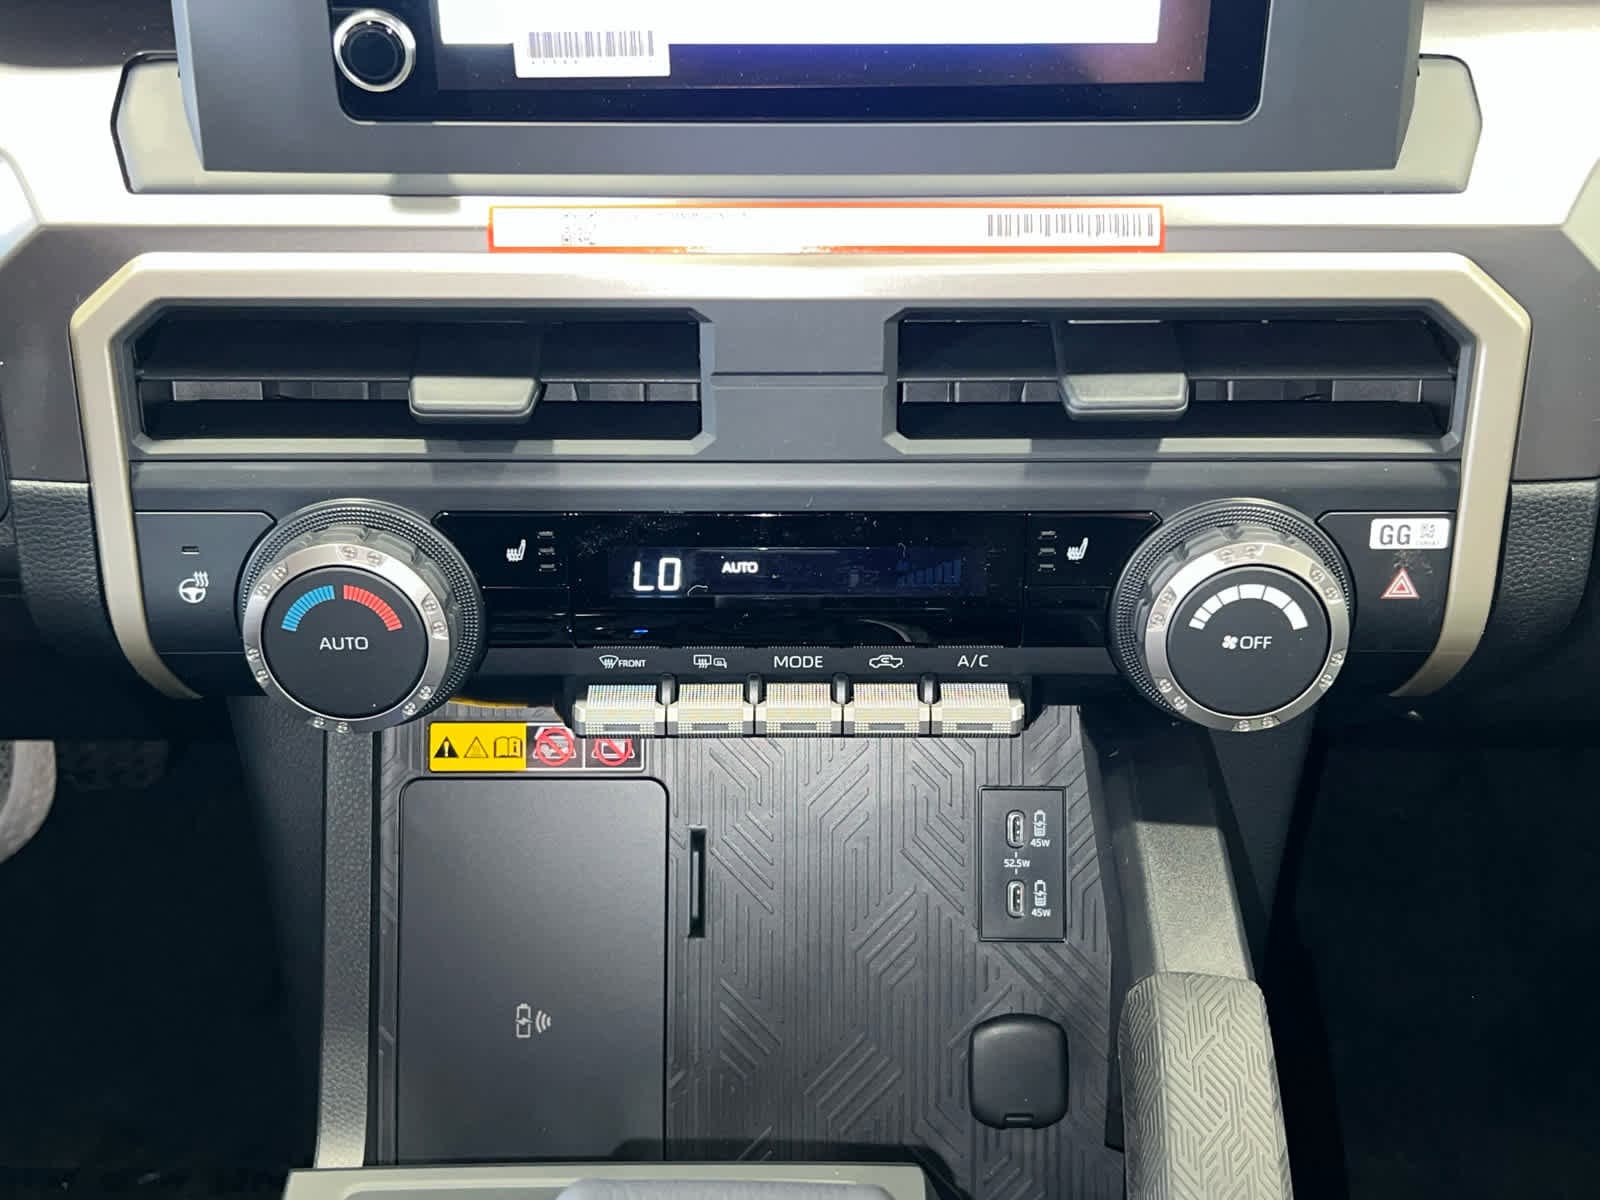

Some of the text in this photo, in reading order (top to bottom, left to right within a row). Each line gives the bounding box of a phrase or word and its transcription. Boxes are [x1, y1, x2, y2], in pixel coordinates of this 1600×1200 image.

[1379, 524, 1412, 546] GG
[721, 561, 760, 574] AUTO
[319, 636, 369, 651] AUTO
[1239, 635, 1273, 650] OFF
[618, 658, 647, 669] FRONT
[773, 655, 824, 669] MODE
[957, 653, 990, 669] A/C
[1030, 839, 1051, 848] 45W
[1003, 859, 1031, 868] 52.5W
[1030, 908, 1052, 918] 45W
